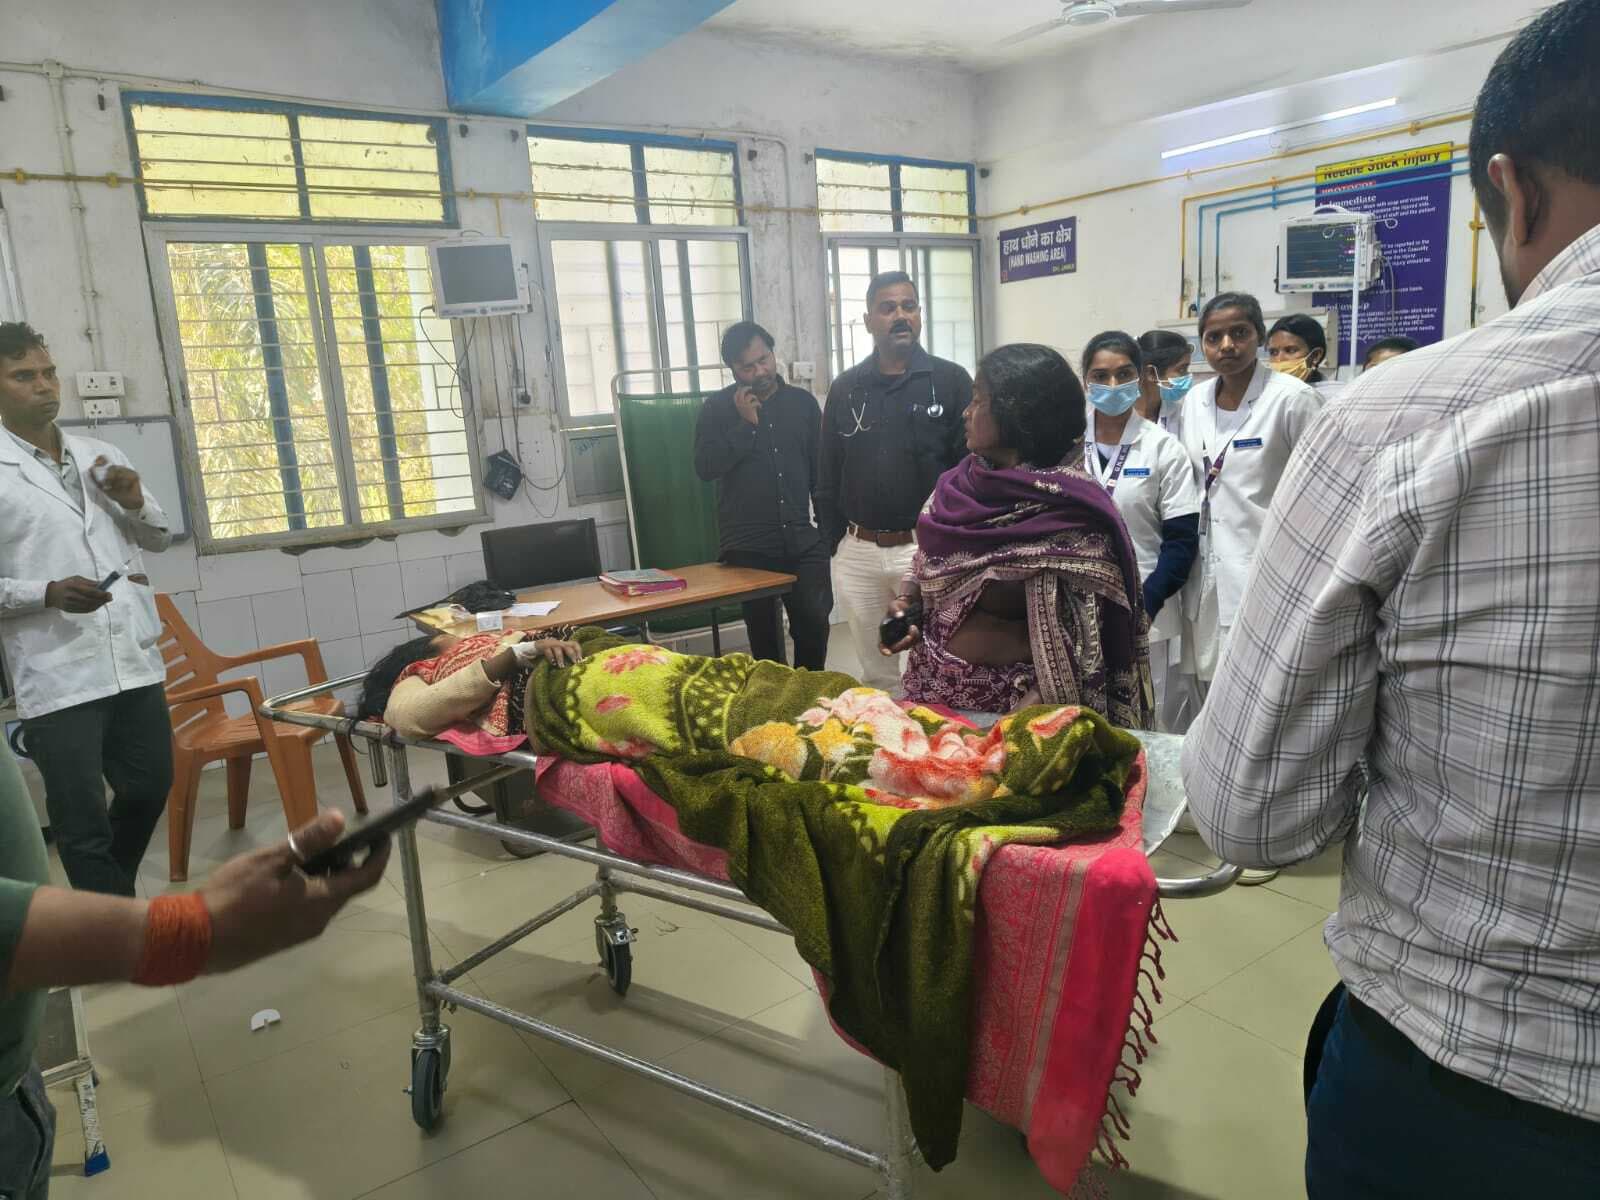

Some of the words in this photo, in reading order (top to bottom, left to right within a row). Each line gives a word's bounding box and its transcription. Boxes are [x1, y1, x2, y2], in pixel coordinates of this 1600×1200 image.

[1323, 163, 1364, 180] Needle
[1367, 156, 1399, 172] Stick
[1002, 238, 1019, 255] हाथ
[1021, 229, 1038, 249] धोने
[1040, 231, 1054, 246] का
[1056, 224, 1072, 243] क्षेत्र
[1008, 254, 1025, 272] (HAND
[1025, 249, 1049, 265] WASHING
[1050, 246, 1067, 262] AREA)
